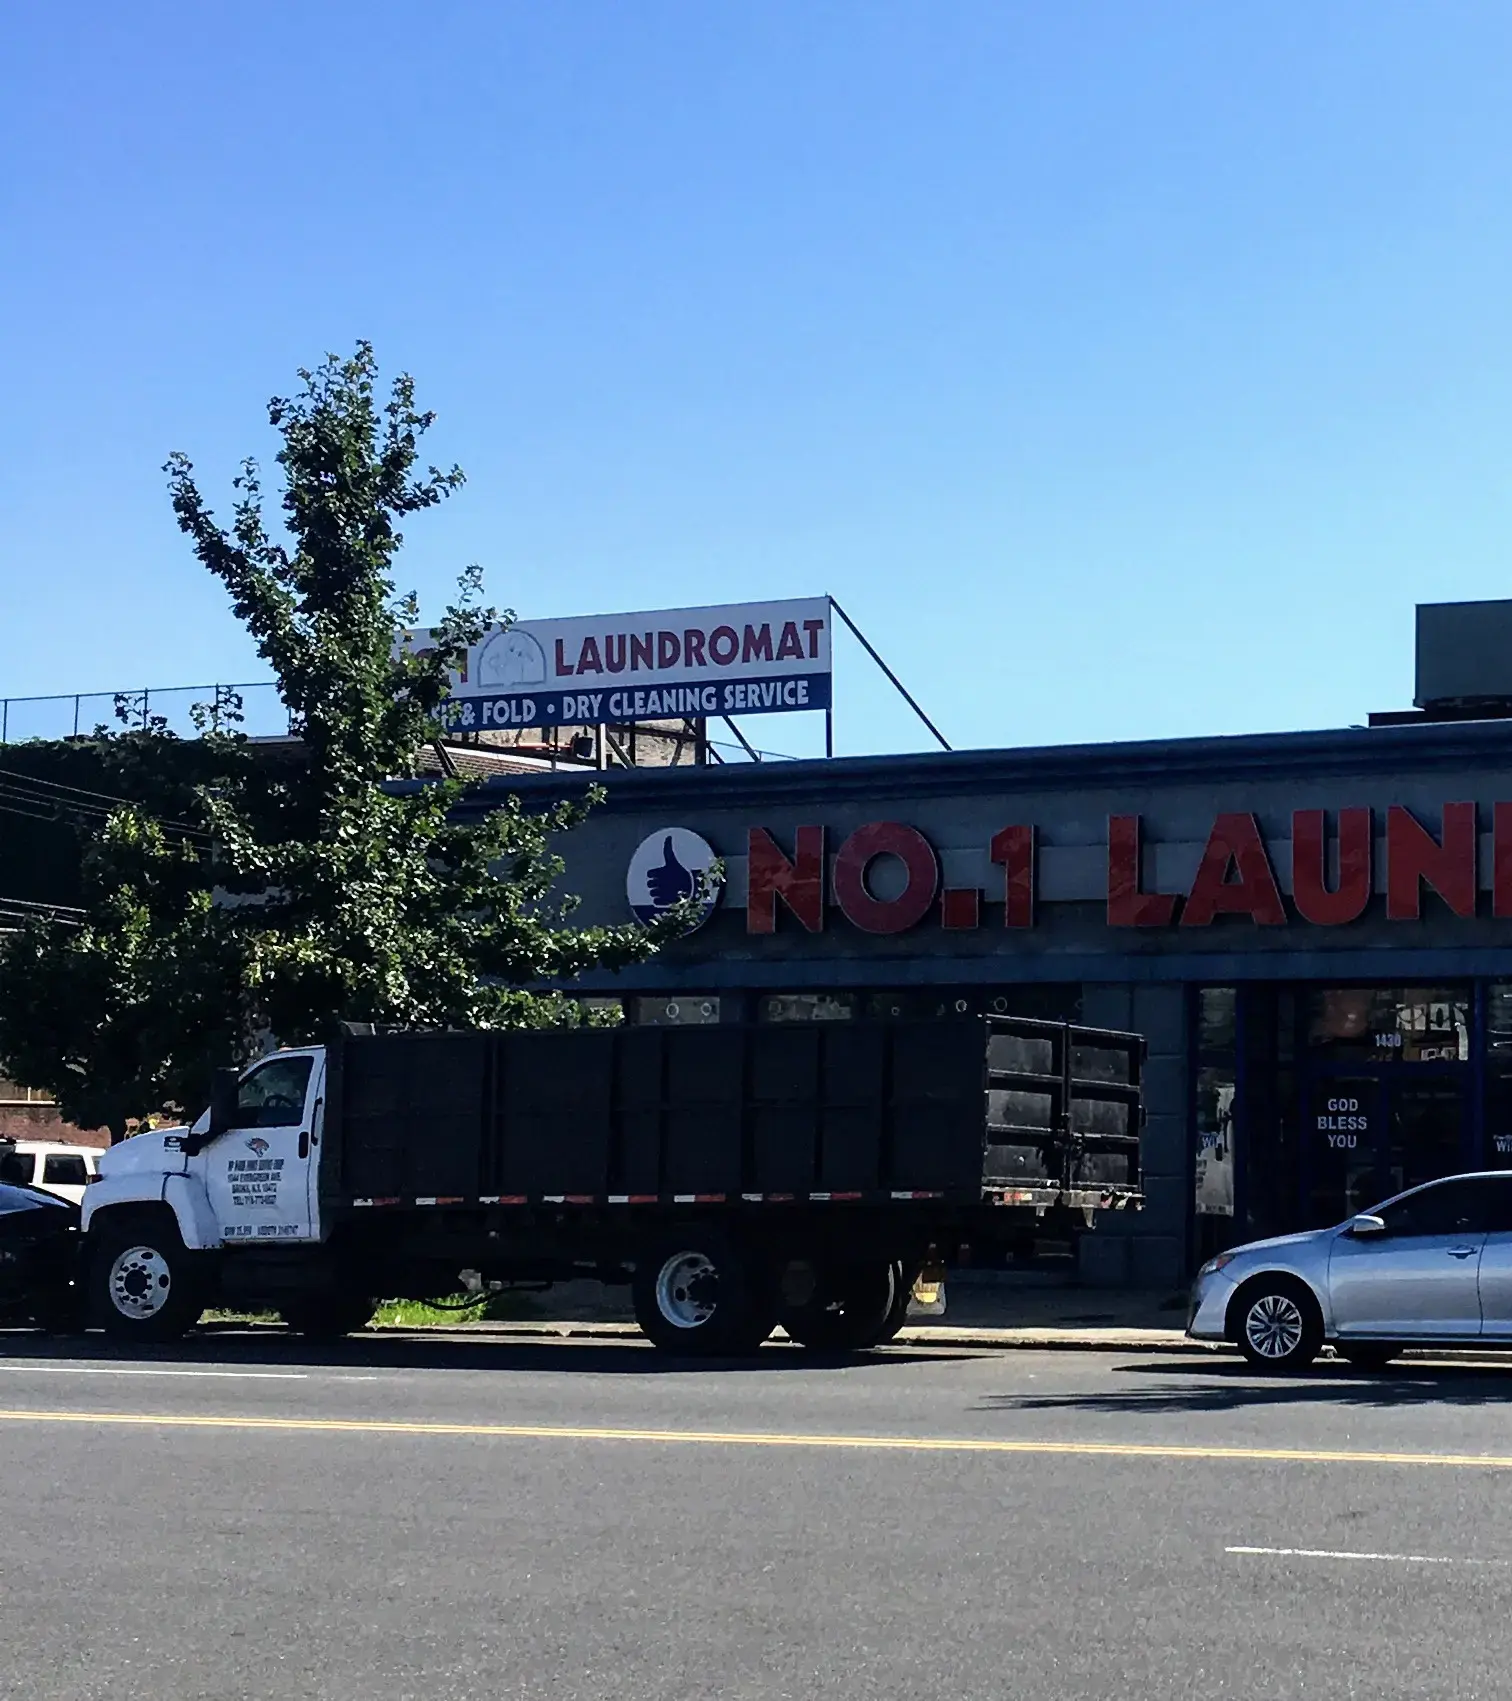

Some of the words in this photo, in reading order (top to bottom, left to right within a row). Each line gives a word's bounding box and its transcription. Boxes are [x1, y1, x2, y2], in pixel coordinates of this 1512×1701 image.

[554, 619, 824, 677] LAUNDROMAT
[482, 698, 537, 725] FOLD
[562, 693, 604, 720] DRY
[608, 686, 718, 717] CLEANING
[724, 680, 809, 710] SERVICE
[1327, 1098, 1359, 1112] GOD
[1317, 1116, 1368, 1131] BLESS
[1327, 1134, 1358, 1149] YOU
